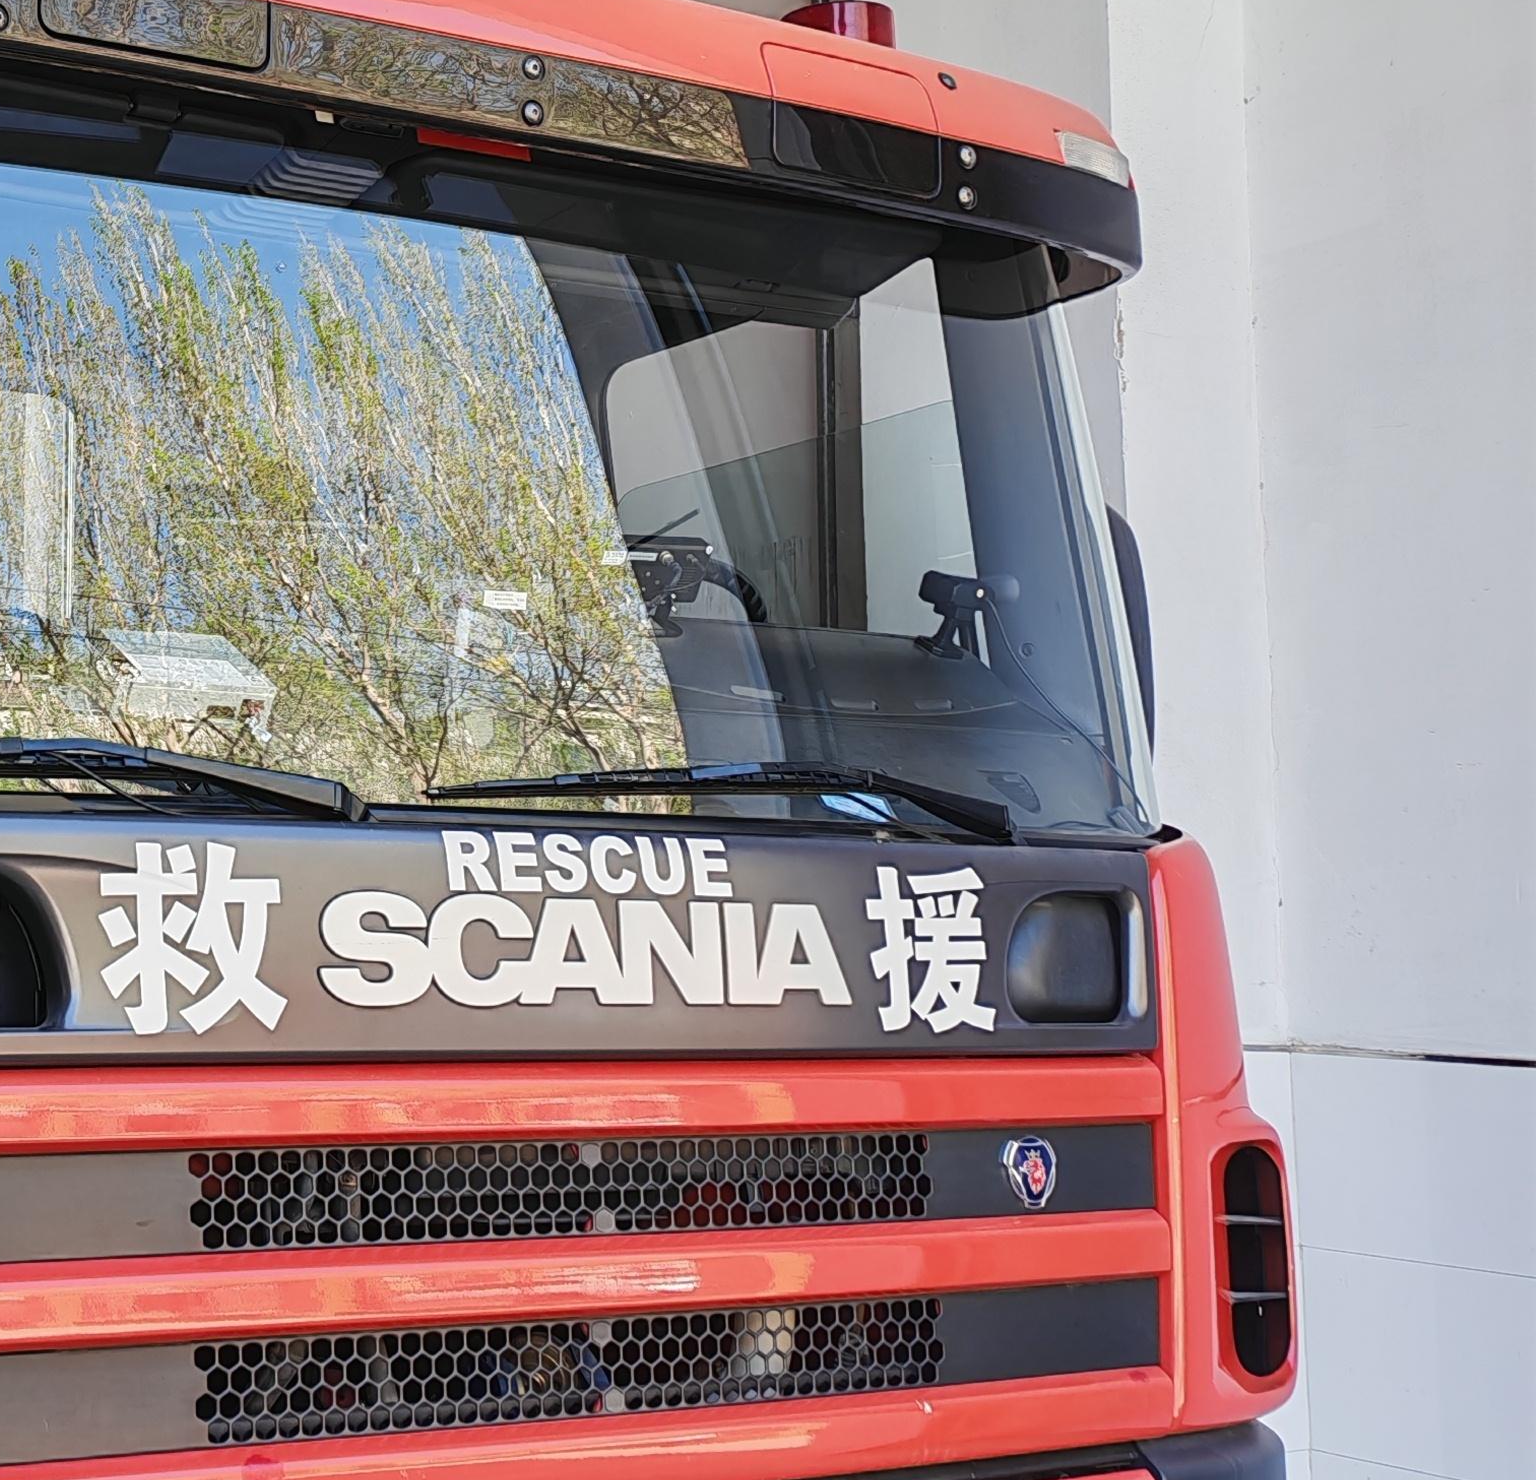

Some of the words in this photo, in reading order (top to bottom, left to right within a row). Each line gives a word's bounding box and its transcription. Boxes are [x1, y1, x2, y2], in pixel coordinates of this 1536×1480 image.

[441, 830, 733, 898] RESCUE
[98, 841, 288, 1036] 救
[865, 865, 997, 1033] 援
[318, 890, 853, 1007] SCANIA
